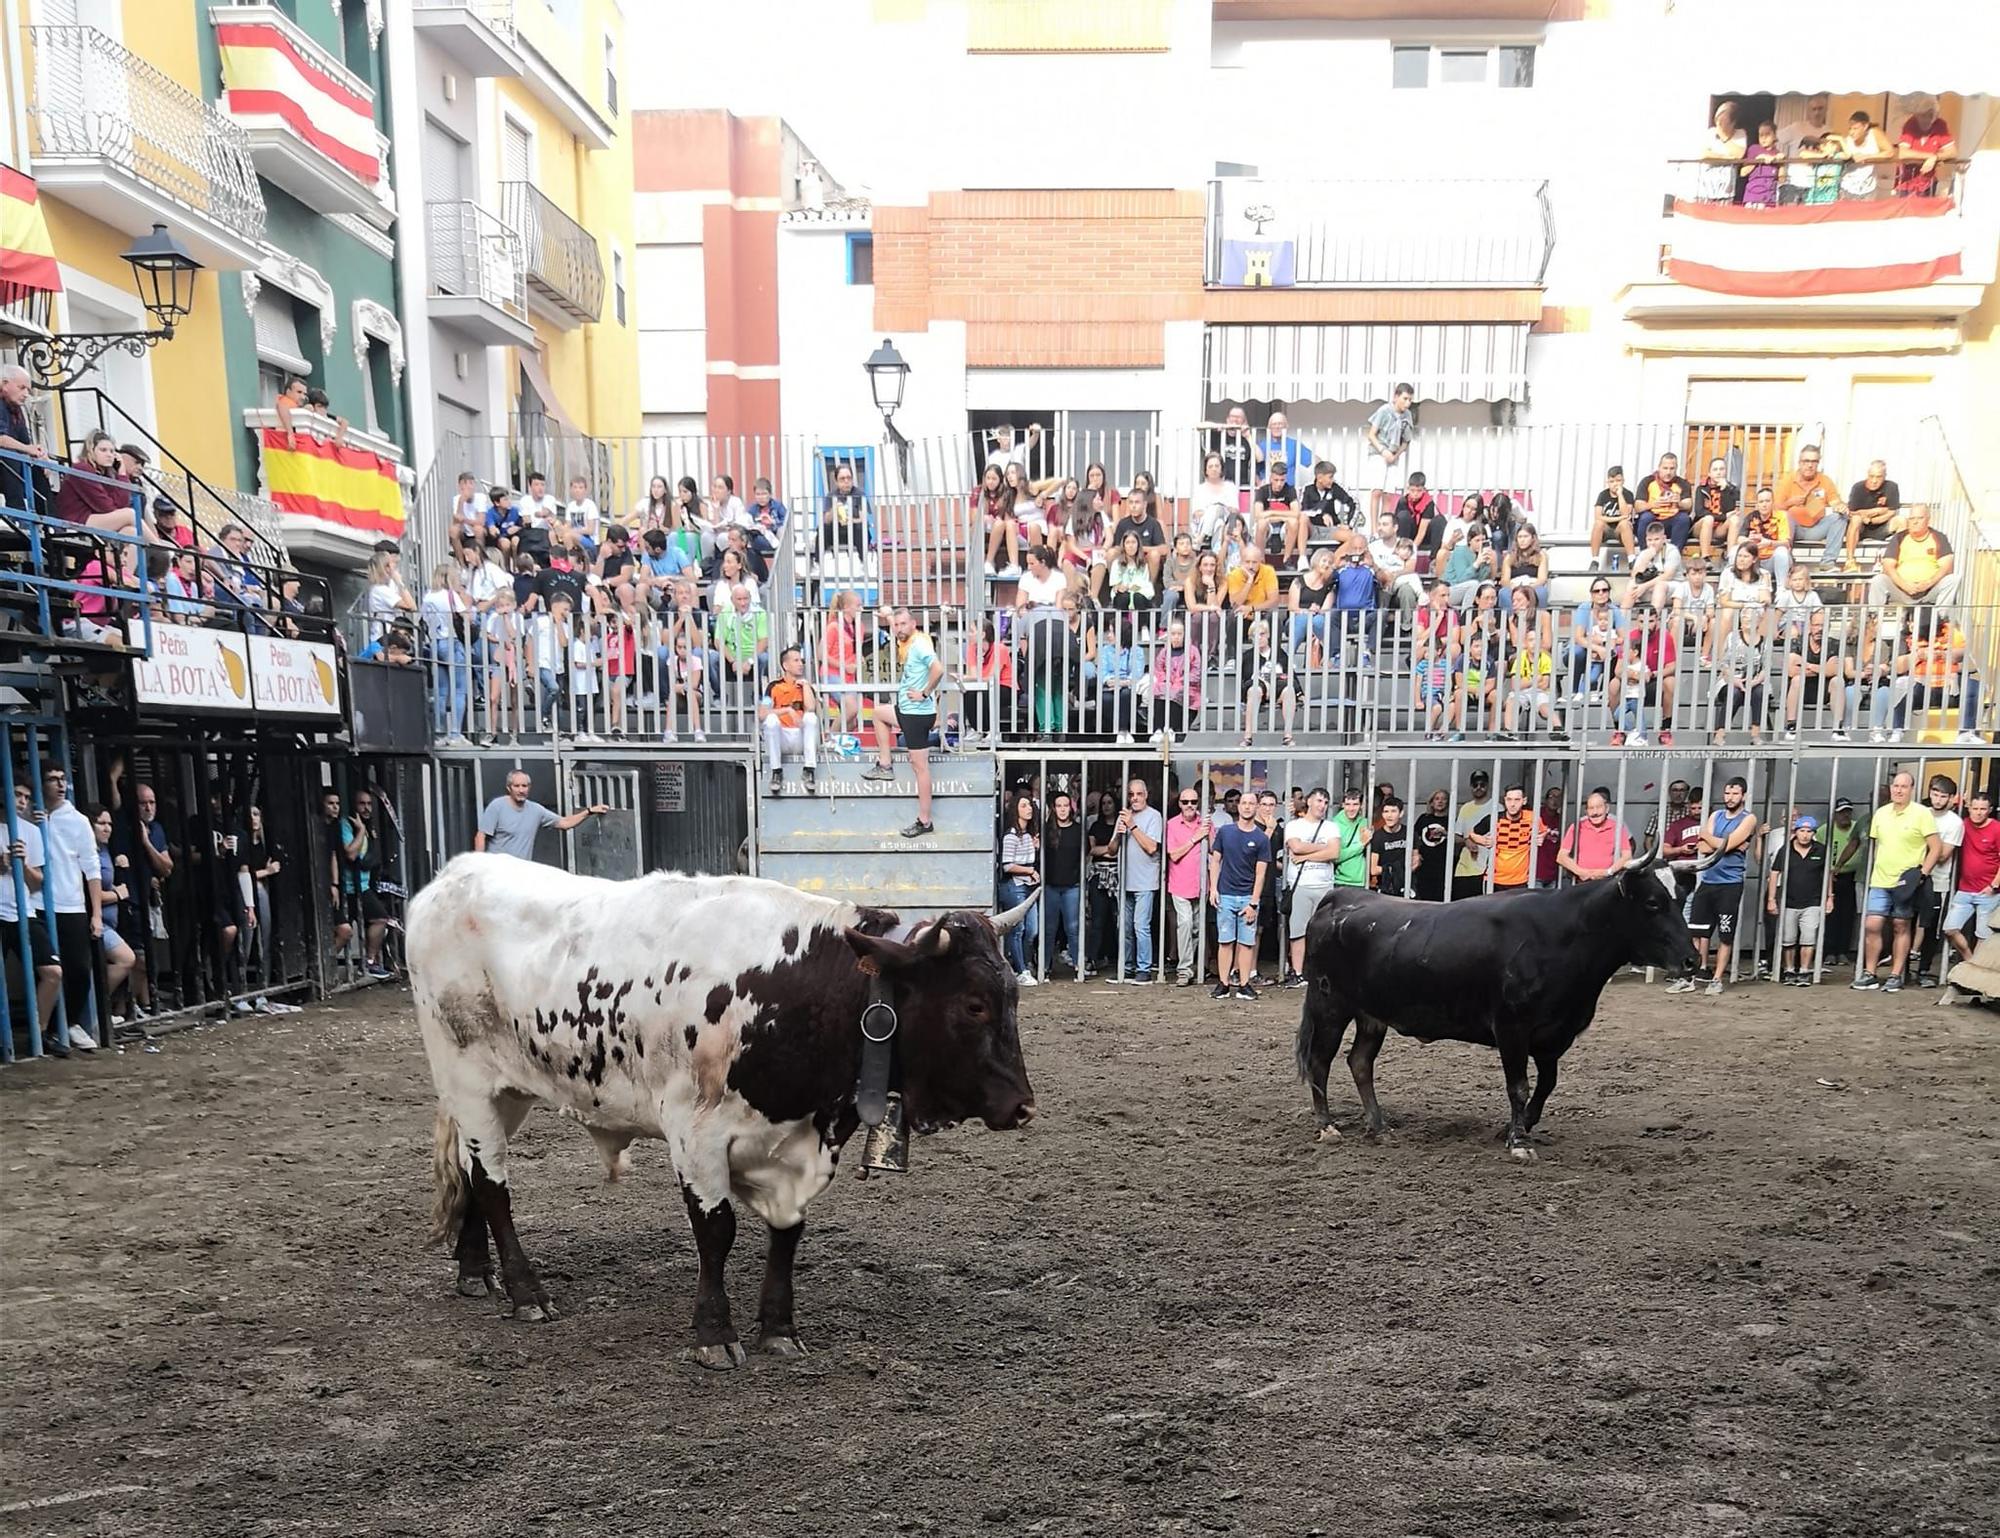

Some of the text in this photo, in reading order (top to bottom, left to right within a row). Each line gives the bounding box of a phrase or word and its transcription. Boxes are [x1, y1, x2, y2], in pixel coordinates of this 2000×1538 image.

[159, 630, 188, 656] Peña
[270, 642, 292, 667] Peña
[139, 661, 219, 697] LA BOTA
[255, 673, 315, 703] LA BOTA
